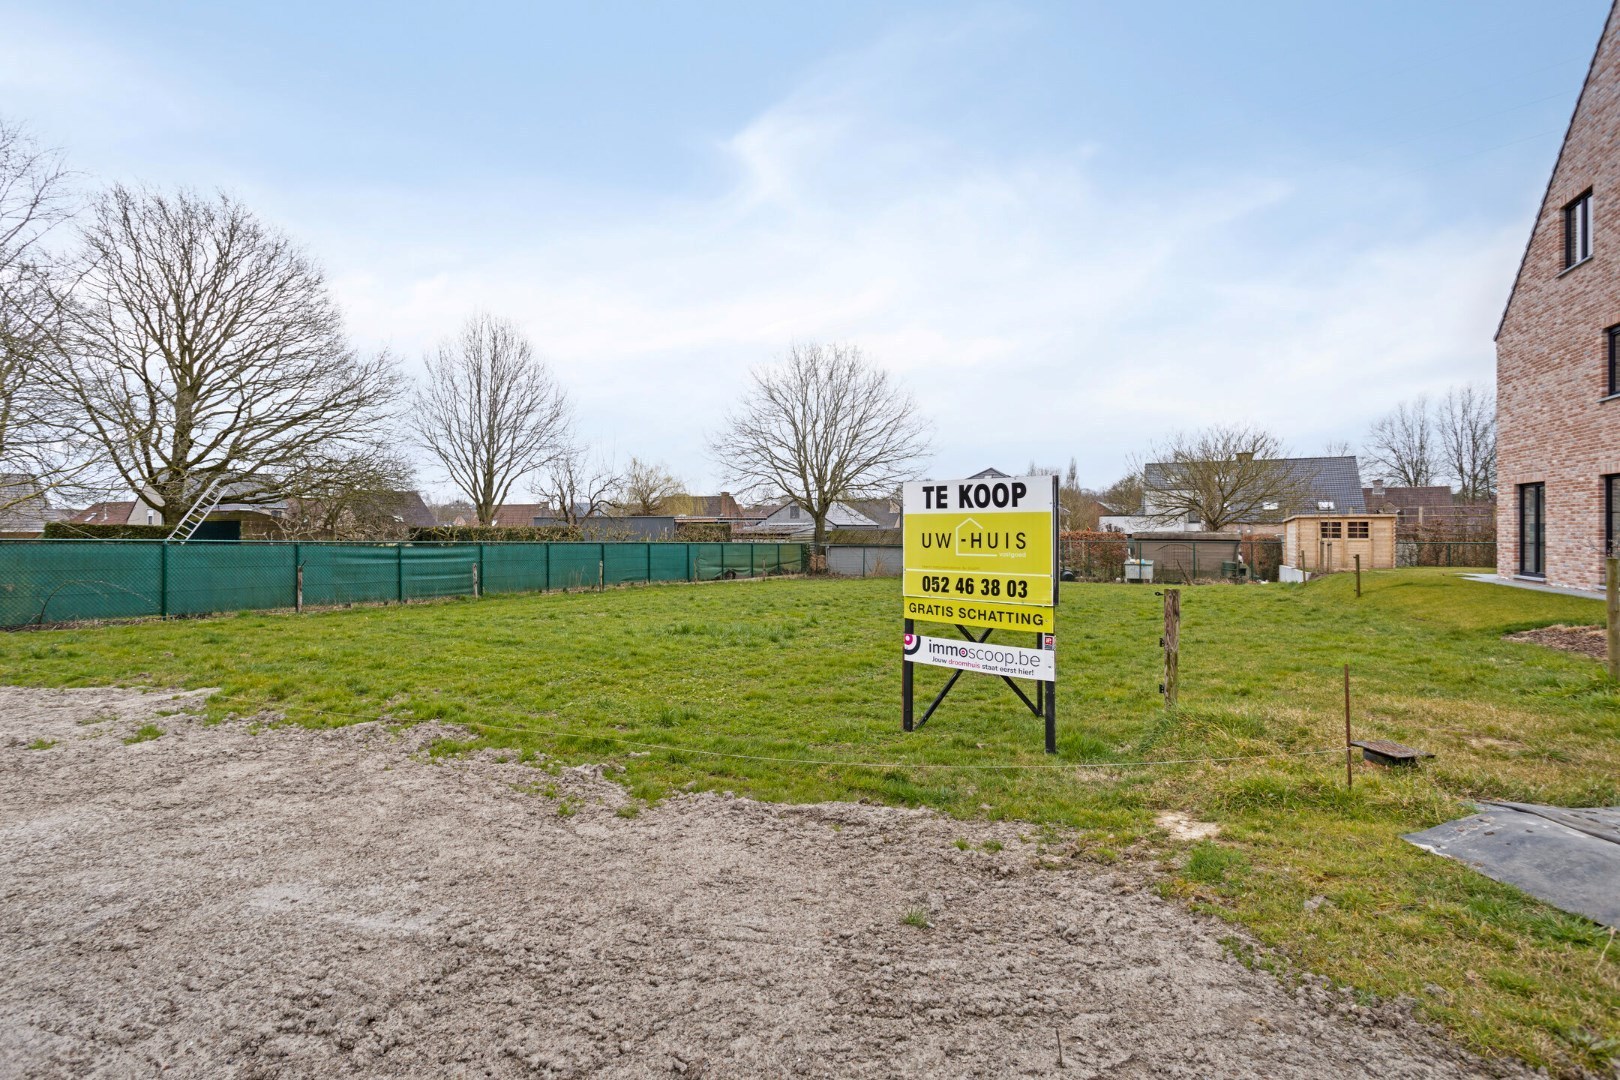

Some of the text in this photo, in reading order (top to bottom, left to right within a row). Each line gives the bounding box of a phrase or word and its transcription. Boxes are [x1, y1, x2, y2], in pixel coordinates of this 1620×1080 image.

[922, 482, 1027, 510] TE KOOP
[921, 575, 1028, 598] 052 46 38 03
[908, 602, 1044, 626] GRATIS SCHATTING
[928, 639, 1041, 668] immoscoop.be
[948, 657, 981, 669] droomhuis
[982, 663, 999, 672] staat
[999, 666, 1017, 674] eerst
[1018, 667, 1034, 676] hier!
